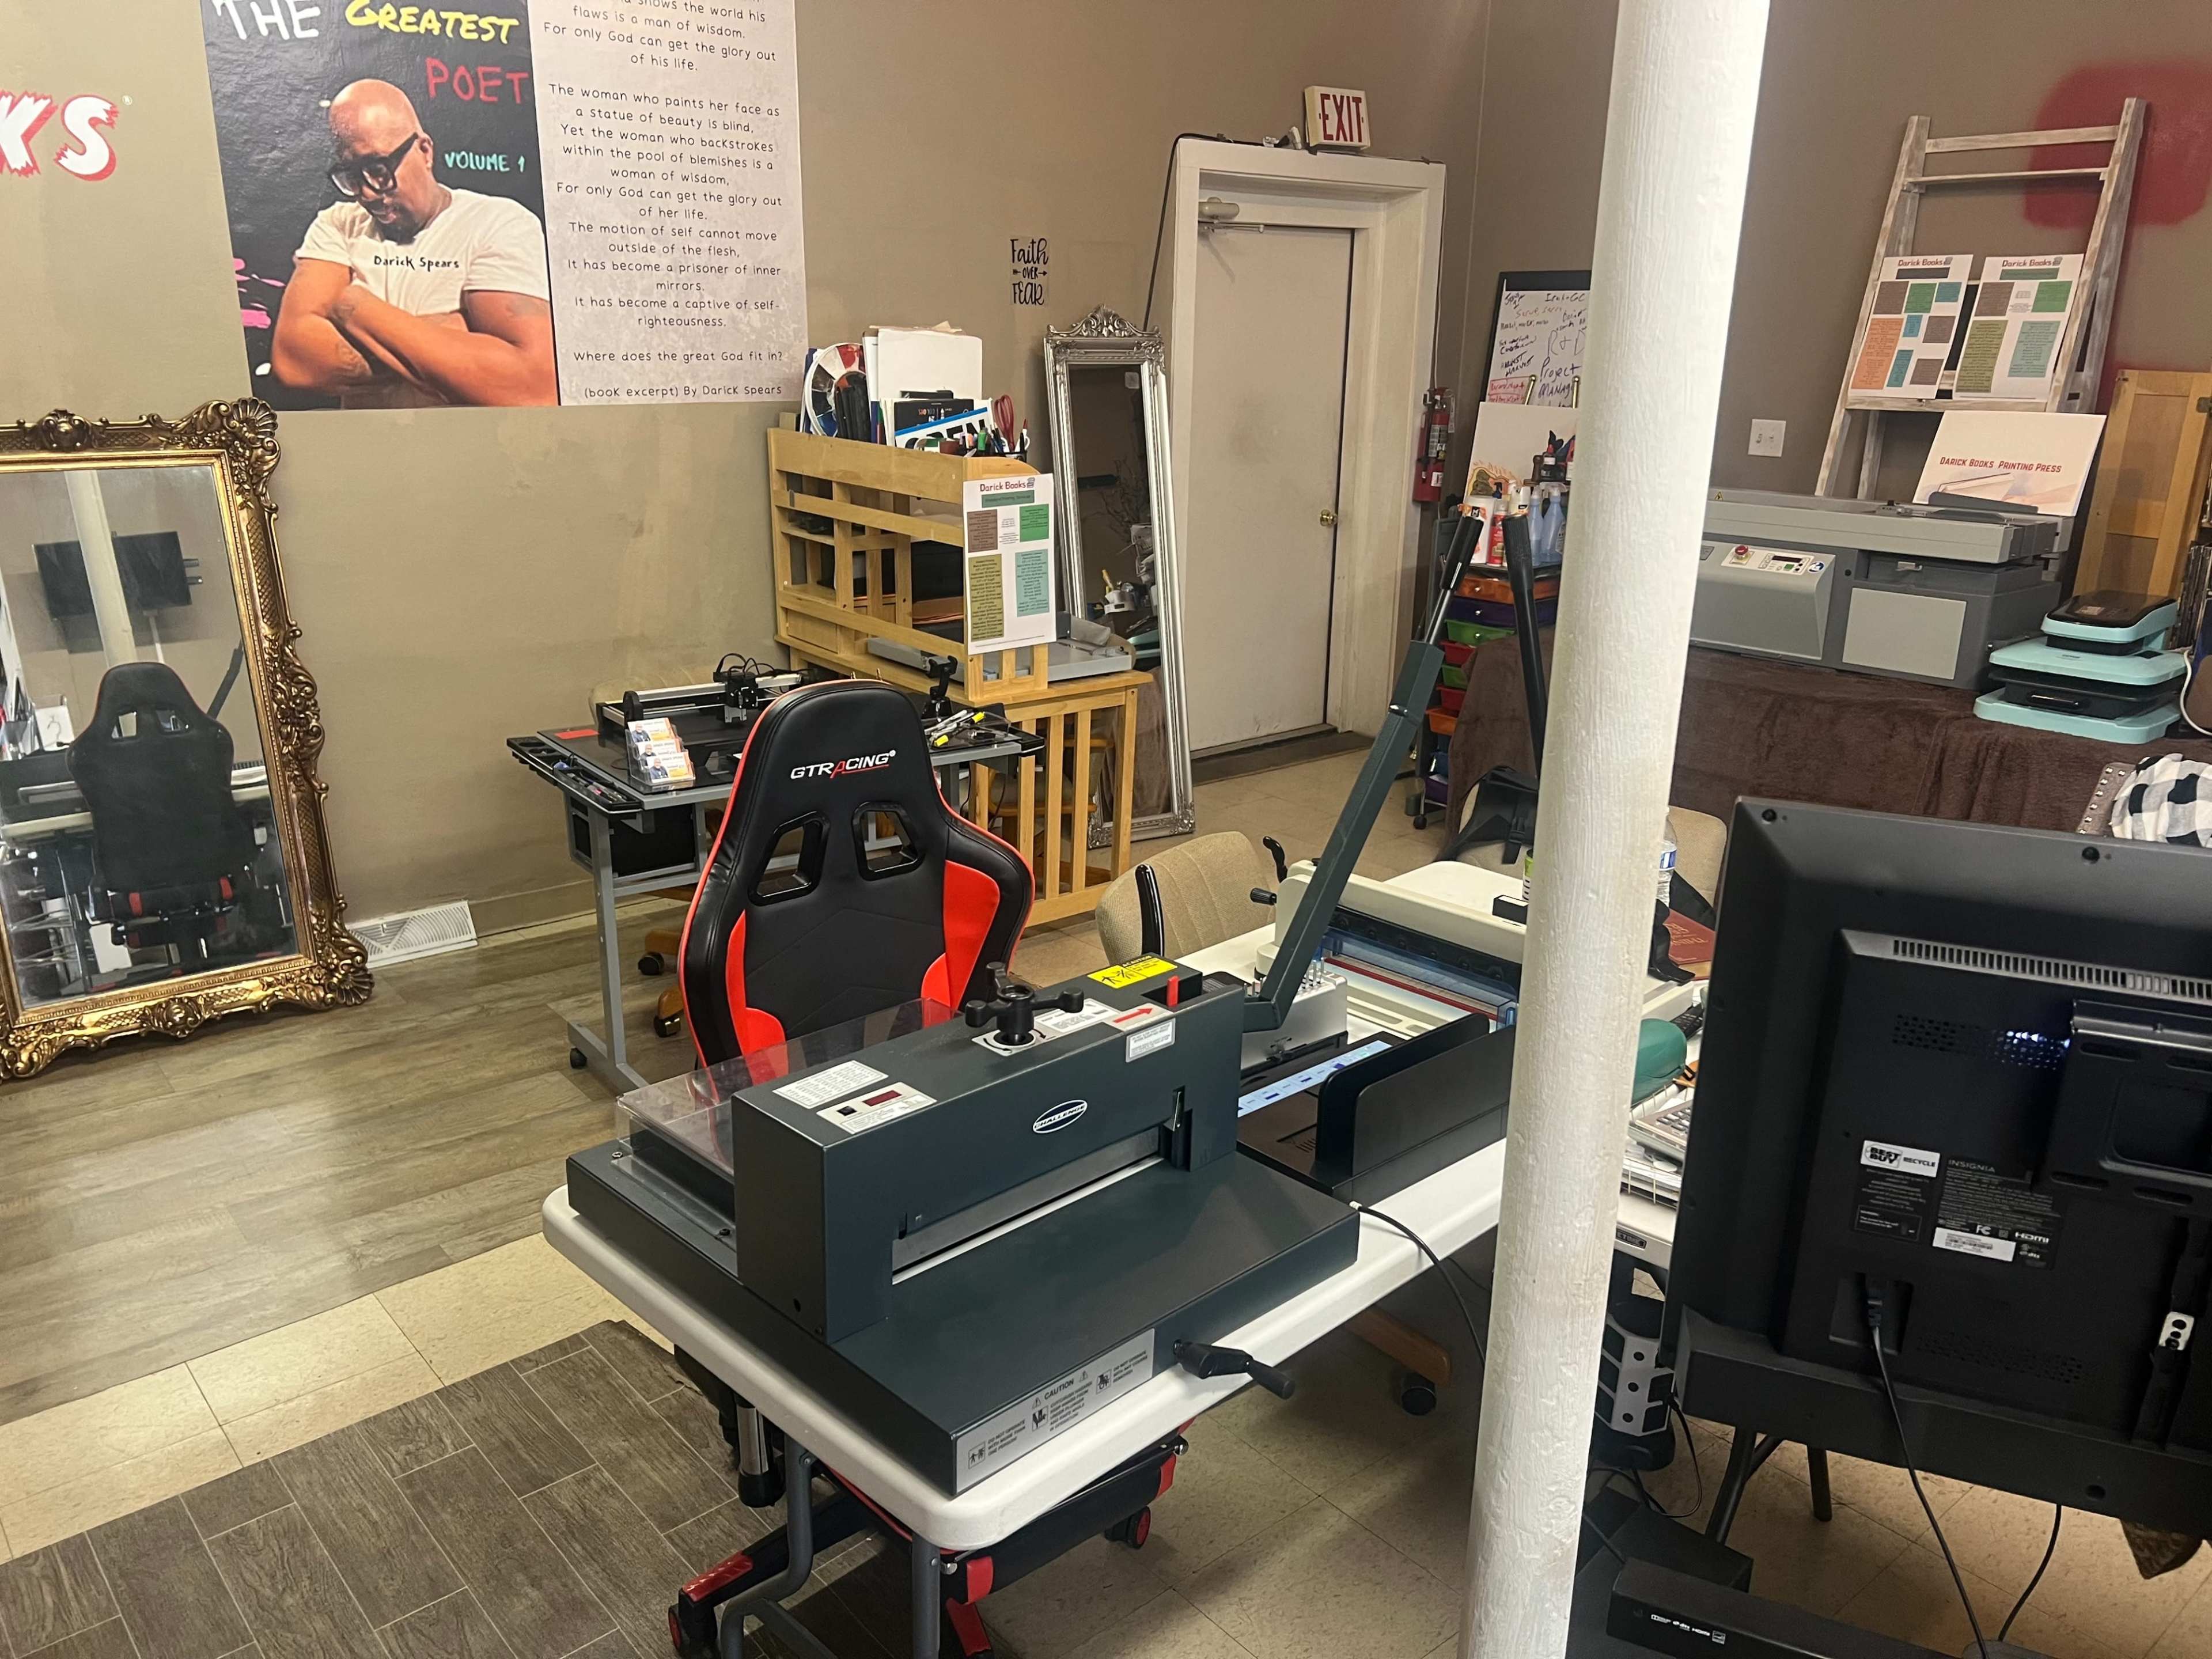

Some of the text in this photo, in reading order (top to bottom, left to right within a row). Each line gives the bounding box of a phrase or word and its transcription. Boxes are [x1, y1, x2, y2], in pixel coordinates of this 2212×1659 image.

[683, 1, 704, 14] the
[710, 7, 744, 20] world
[749, 9, 766, 22] his
[217, 0, 518, 44] THE GREATEST
[573, 5, 745, 39] flaws is a man of wisdom.
[544, 21, 776, 62] For only God can get the glory out
[630, 53, 698, 71] of his life.
[425, 56, 529, 104] POET
[548, 82, 779, 116] The woman who paints her face as
[575, 108, 584, 116] a
[590, 108, 633, 122] statue
[639, 112, 653, 123] of
[659, 114, 702, 130] beauty
[708, 119, 717, 129] is
[1320, 93, 1362, 142] EXIT
[560, 123, 774, 153] Yet the woman who backstrokes
[444, 150, 525, 173] VOLUME 1
[562, 144, 773, 170] within the pool of blemishes is a
[610, 169, 656, 180] woman
[661, 170, 675, 181] of
[556, 181, 782, 207] For only God can get the glory out
[639, 206, 707, 220] of her life.
[568, 221, 777, 241] The motion of self cannot move
[608, 243, 656, 253] outside
[662, 244, 675, 254] of
[681, 244, 702, 256] the
[1010, 238, 1048, 265] Faith
[374, 255, 460, 272] Darick Spears
[568, 259, 578, 269] It
[583, 258, 606, 270] has
[611, 260, 661, 272] become
[679, 263, 729, 275] prisoner
[734, 264, 747, 274] of
[753, 265, 781, 276] inner
[2002, 259, 2027, 267] Darick
[1022, 267, 1038, 279] OVER
[656, 281, 704, 291] mirrors.
[575, 296, 779, 312] It has become a captive of self-
[638, 315, 726, 329] righteousness.
[573, 350, 782, 364] Where does the great God fit in?
[585, 385, 782, 399] (book excerpt) By Darick Spears
[1940, 457, 2062, 473] DARICK BOOKS PRINTING PRESS
[980, 480, 1026, 491] Darick Books
[790, 752, 891, 779] GTRACING
[1870, 1147, 1900, 1158] BEST
[1870, 1153, 1936, 1167] BUY RECYCLE
[1948, 1160, 1995, 1173] INSIGNIA
[1044, 1378, 1074, 1400] CAUTION
